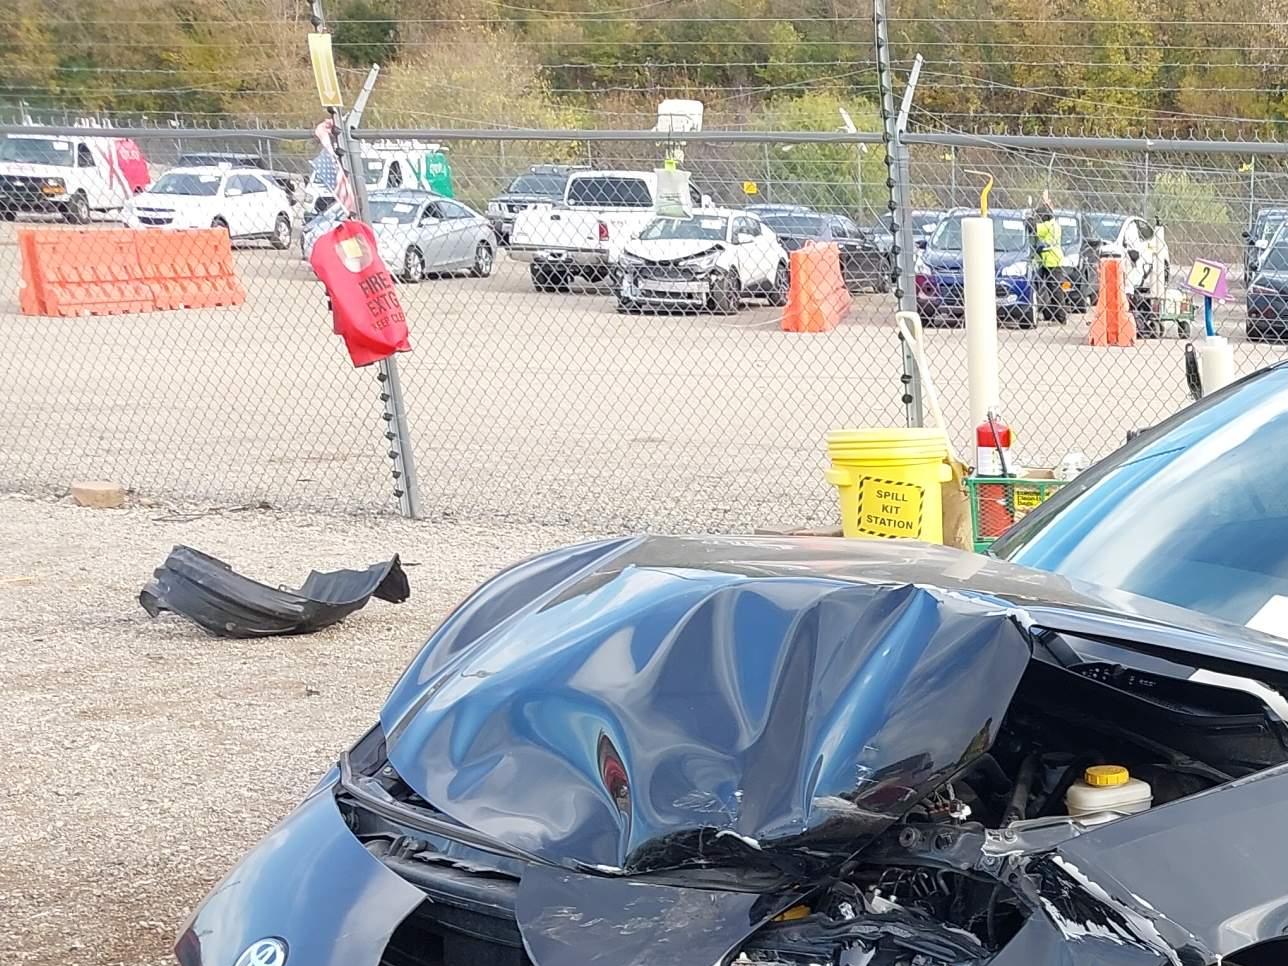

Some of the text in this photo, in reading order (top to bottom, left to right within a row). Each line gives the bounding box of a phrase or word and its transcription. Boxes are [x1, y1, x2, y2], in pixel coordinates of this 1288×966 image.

[358, 271, 391, 298] FIRE
[1198, 267, 1211, 288] 2
[876, 489, 908, 503] SPILL
[881, 505, 902, 515] KIT
[866, 514, 914, 530] STATION
